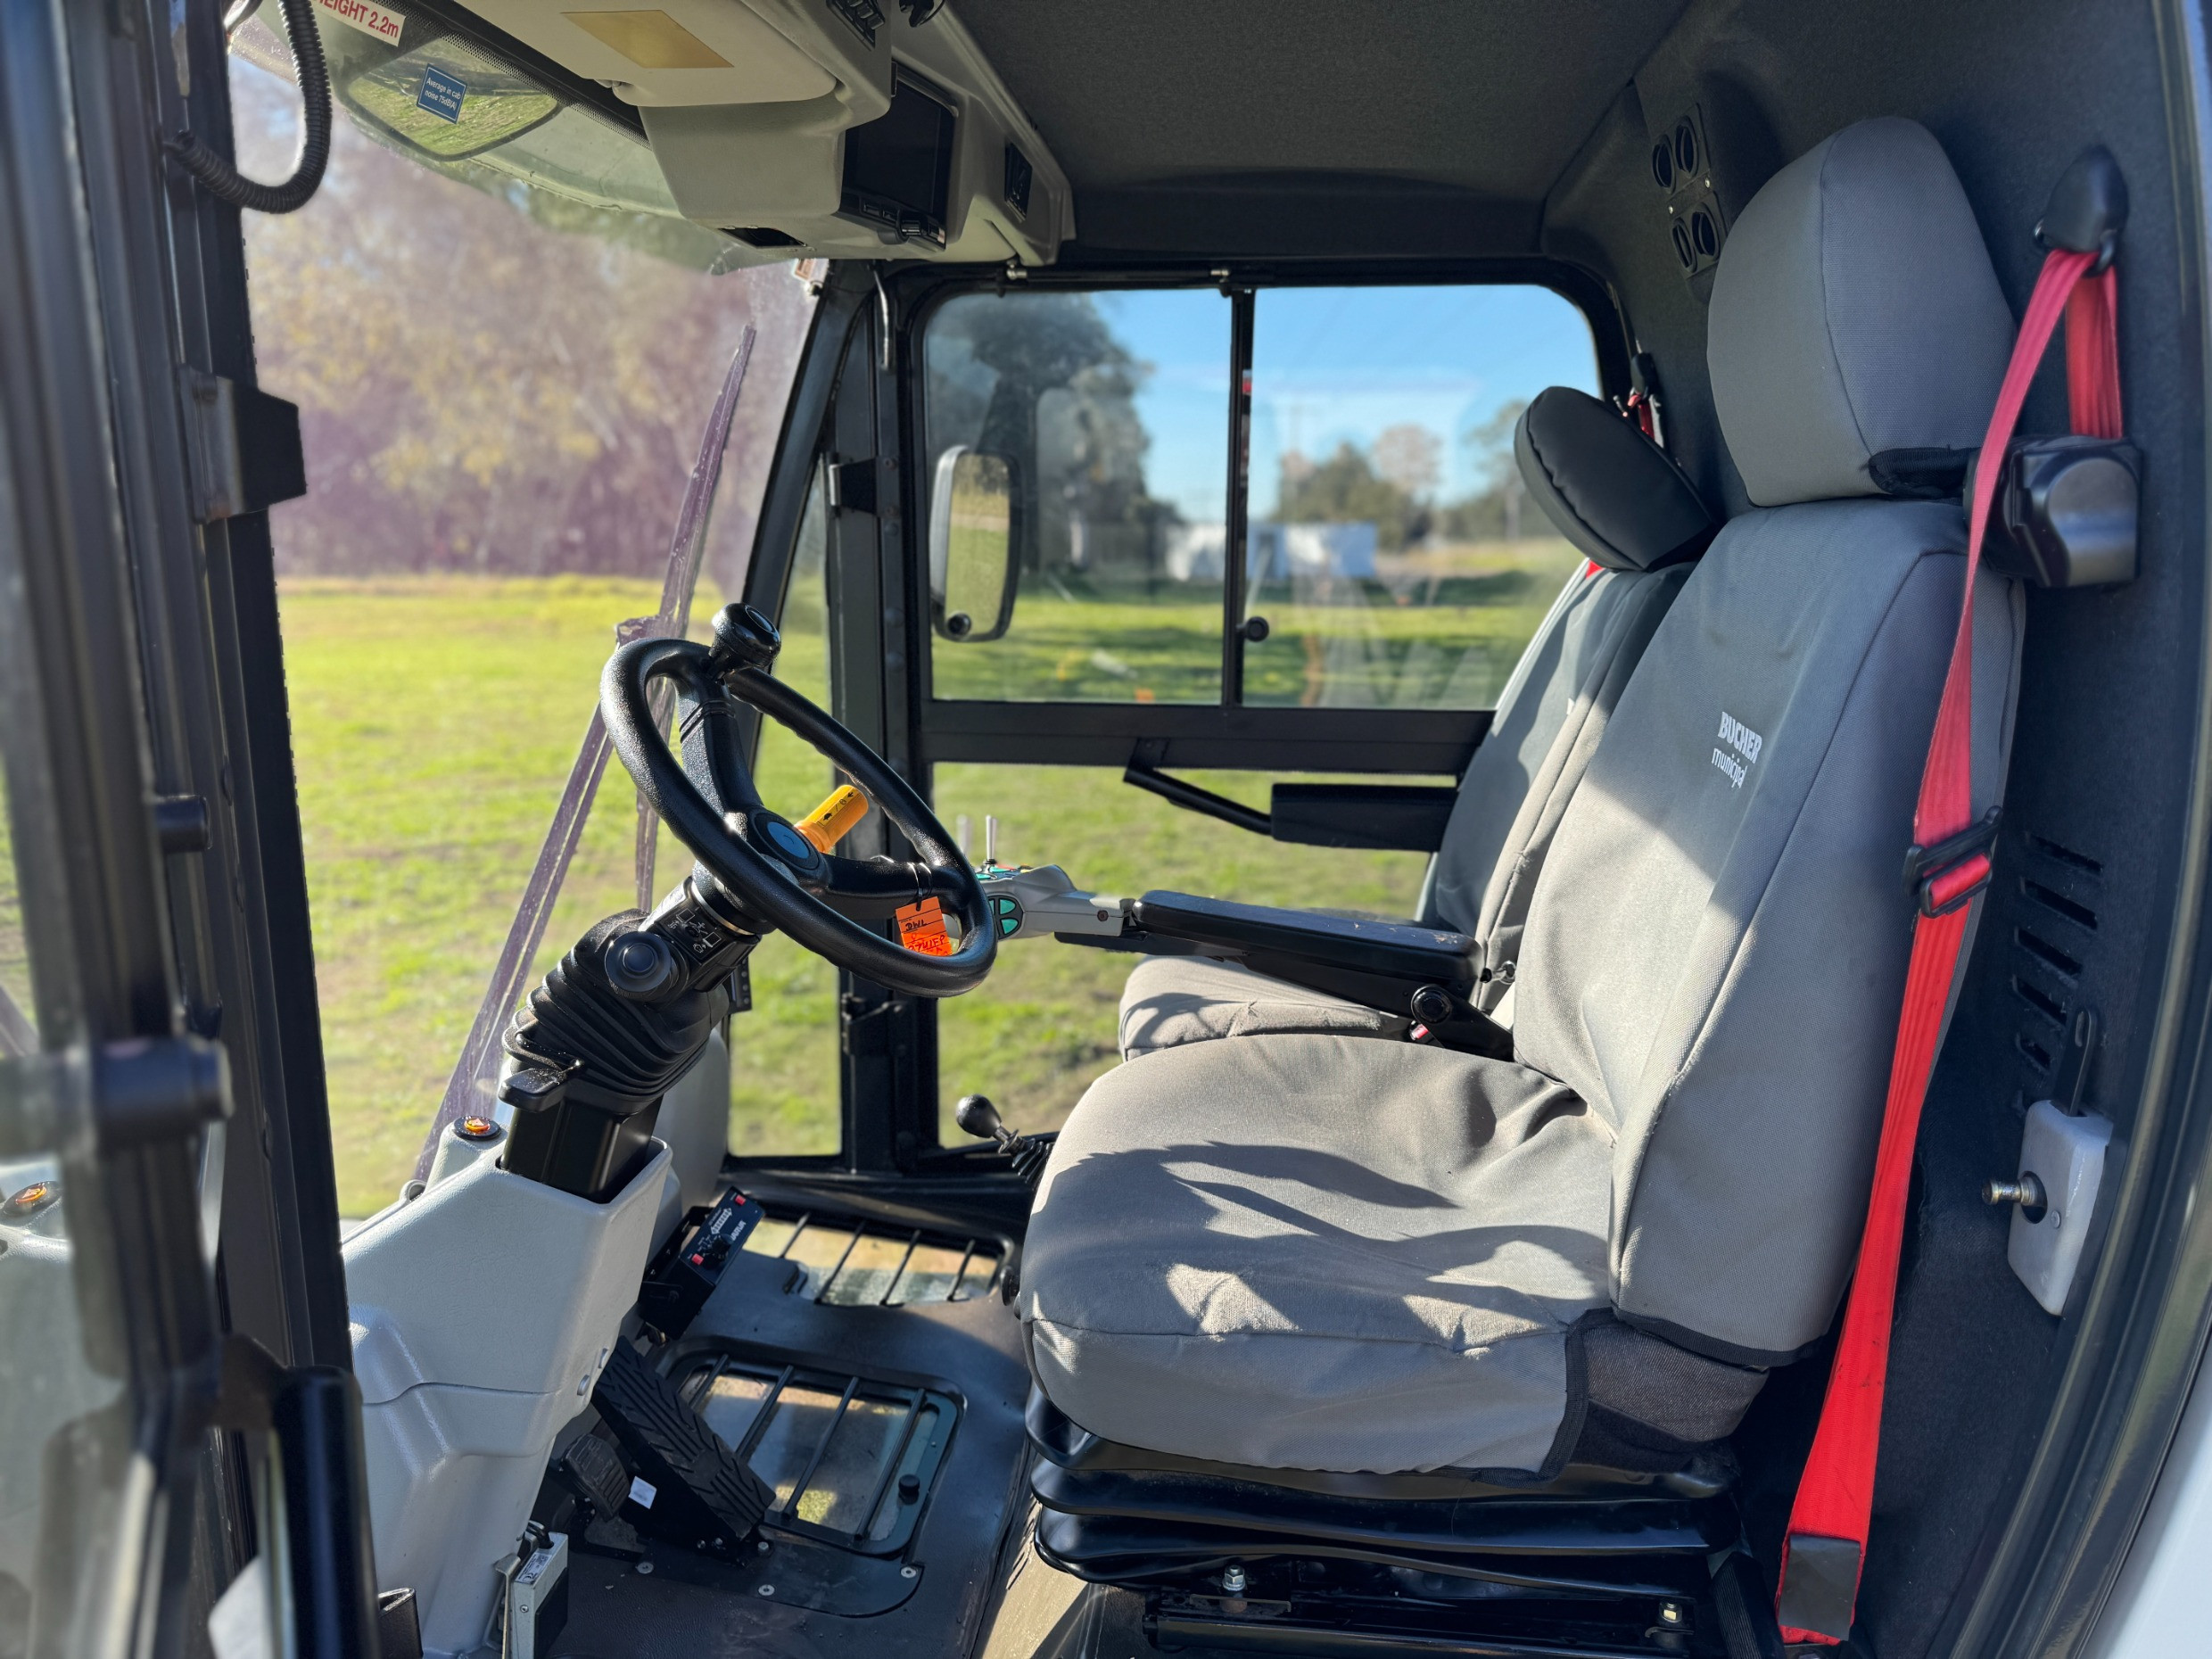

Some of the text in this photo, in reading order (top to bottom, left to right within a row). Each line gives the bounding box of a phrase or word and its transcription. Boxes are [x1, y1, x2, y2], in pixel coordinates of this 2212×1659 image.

[368, 12, 399, 37] 2.2m
[425, 90, 439, 100] noise
[426, 78, 447, 93] Average
[1718, 711, 1762, 763] BUCHER
[1712, 747, 1748, 788] municipal
